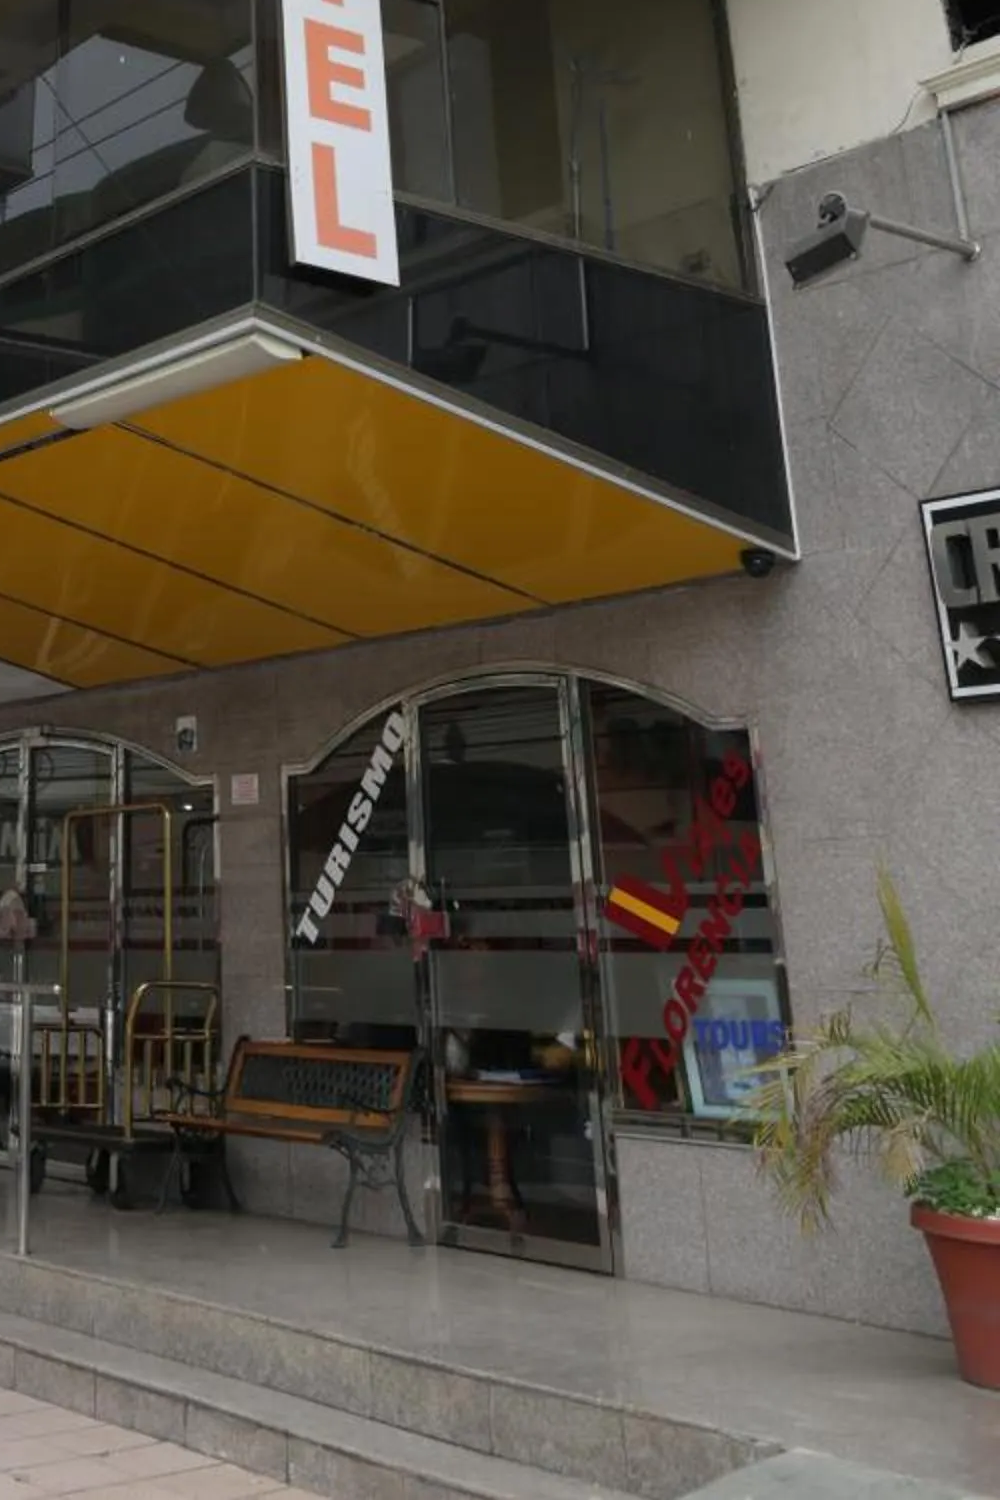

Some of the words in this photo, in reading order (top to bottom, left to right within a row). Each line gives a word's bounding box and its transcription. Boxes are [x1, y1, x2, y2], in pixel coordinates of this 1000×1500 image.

[296, 711, 405, 946] TURISMO
[620, 830, 763, 1111] FLORENCIA
[692, 1017, 785, 1052] TOURS
